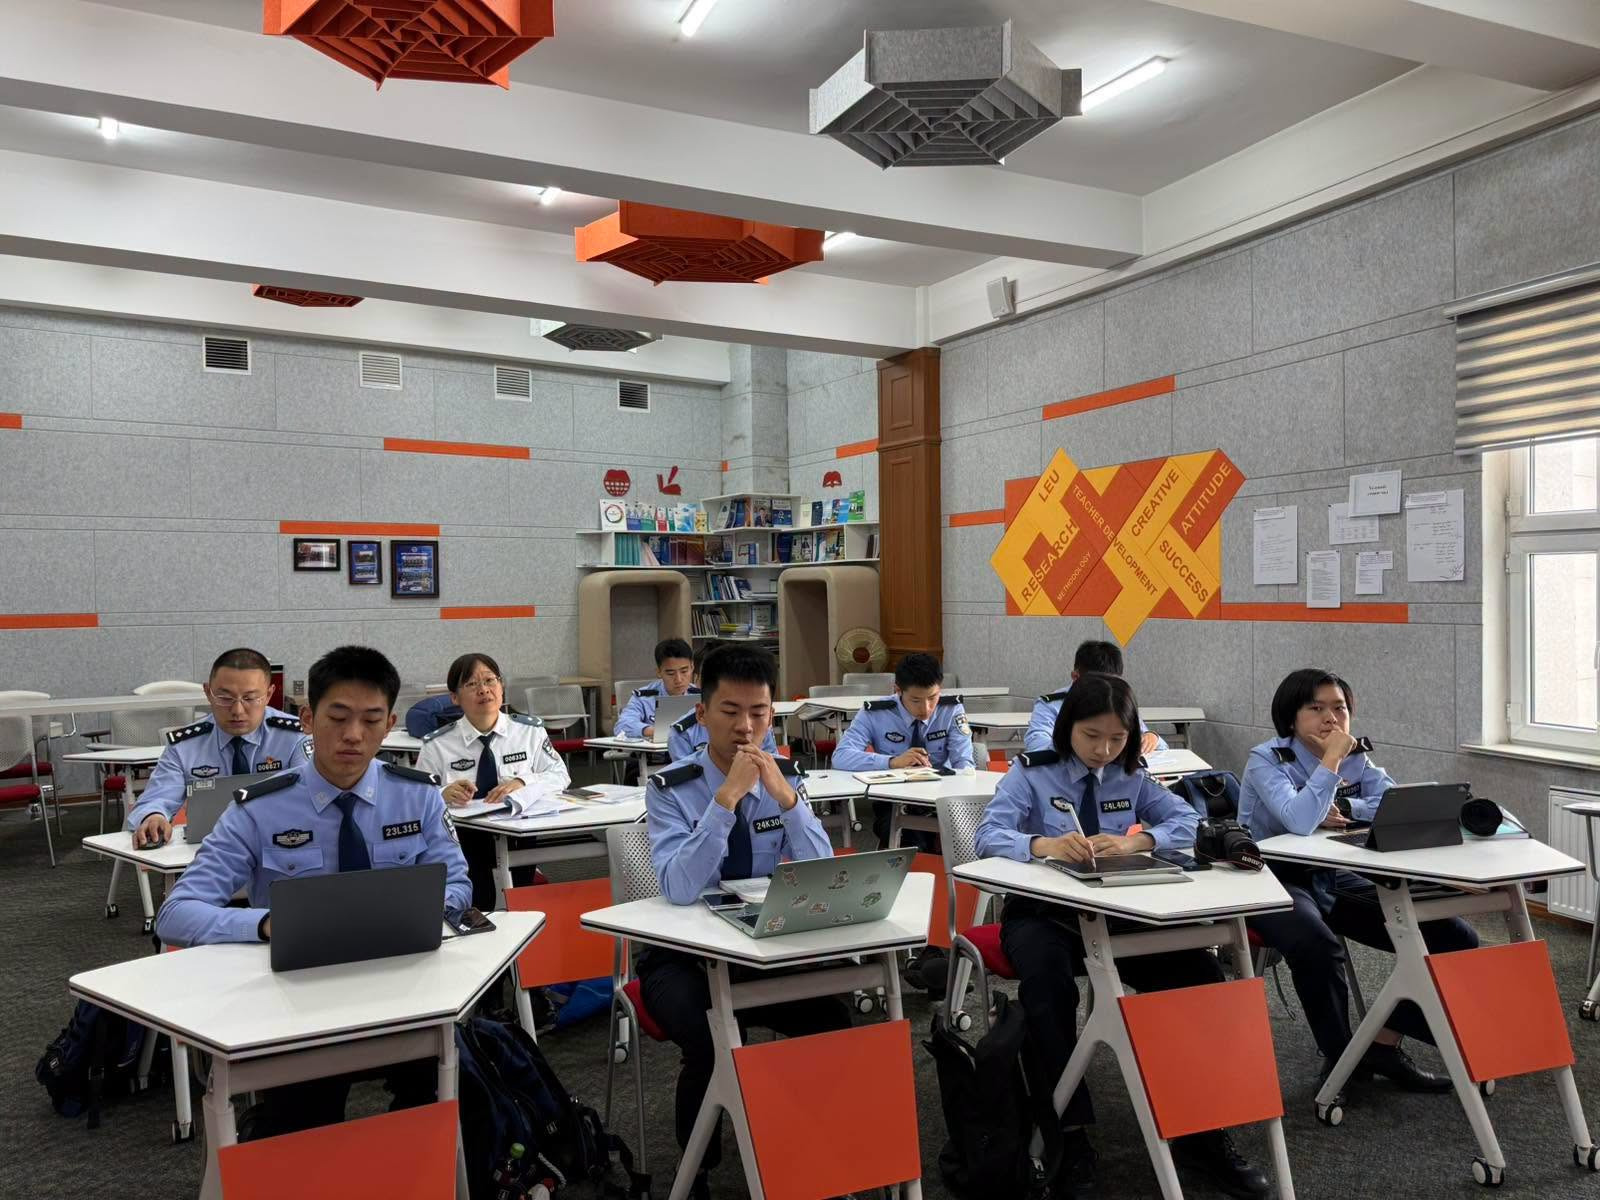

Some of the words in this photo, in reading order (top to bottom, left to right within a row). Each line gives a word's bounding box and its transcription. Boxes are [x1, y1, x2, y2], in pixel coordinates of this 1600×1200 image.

[1038, 469, 1060, 503] LEU
[1131, 468, 1180, 537] CREATIVE
[1180, 462, 1232, 535] ATTITUDE
[1020, 518, 1078, 602] RESEARCH
[1072, 484, 1105, 530] TEACHER
[1102, 524, 1158, 597] DEVELOPMENT
[1159, 540, 1209, 602] SUCCESS
[1056, 551, 1092, 602] METHODOLOGY
